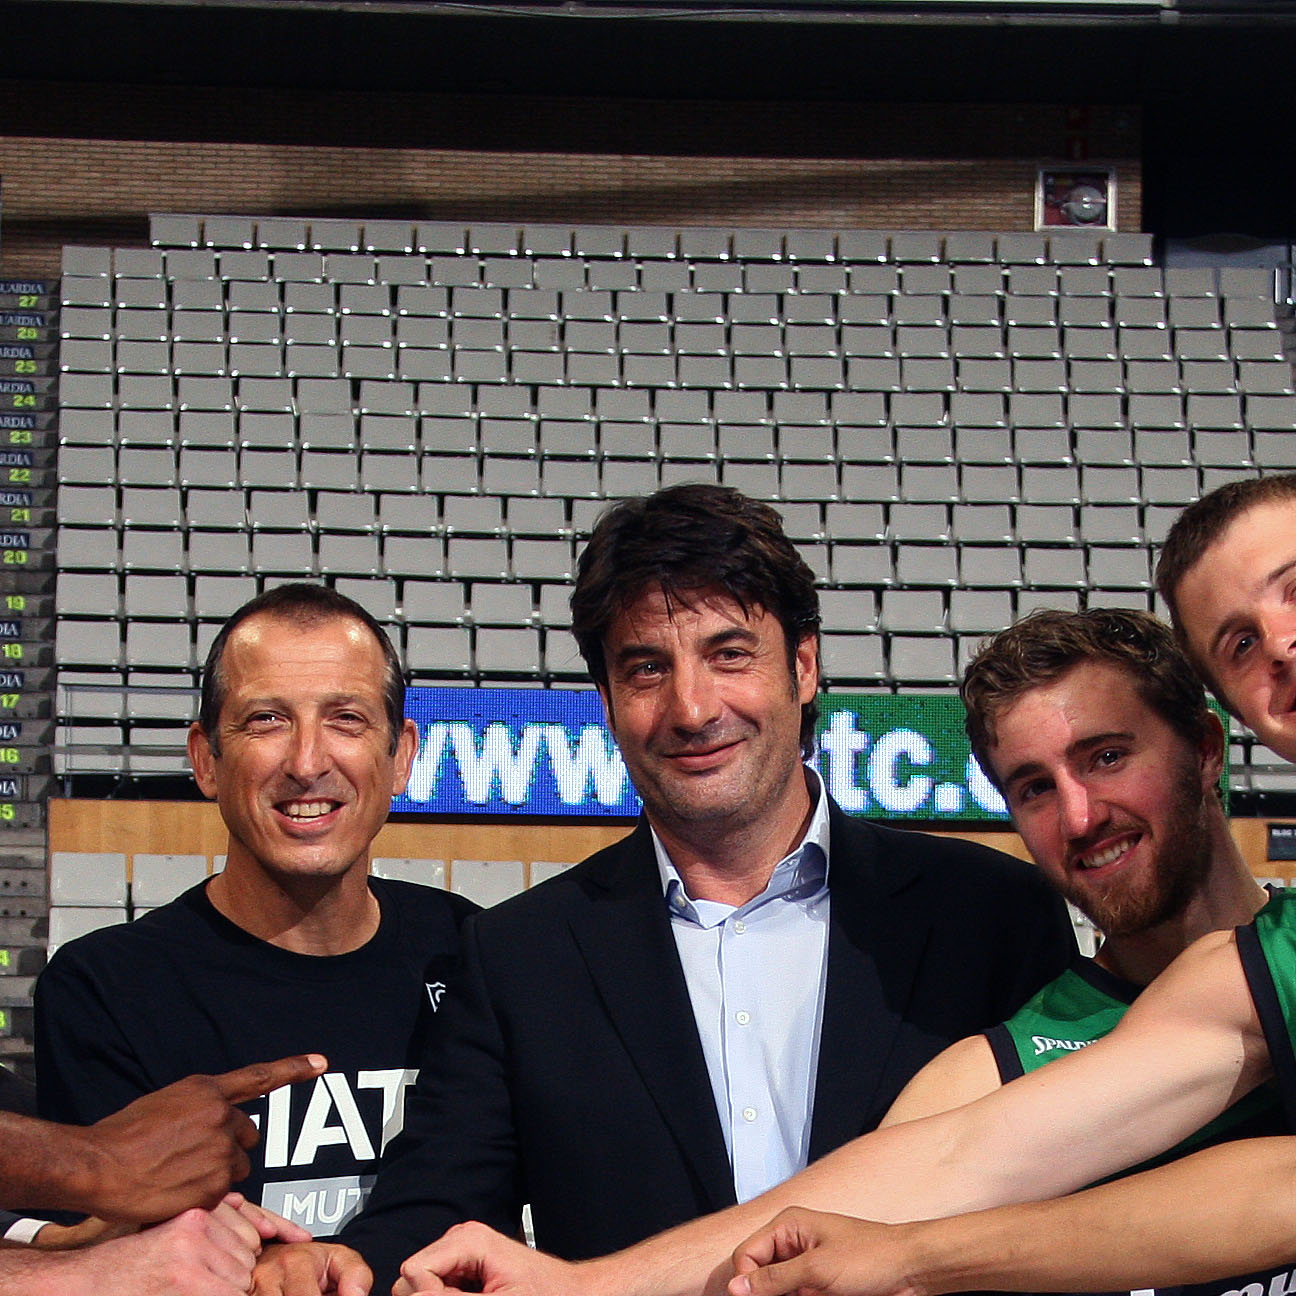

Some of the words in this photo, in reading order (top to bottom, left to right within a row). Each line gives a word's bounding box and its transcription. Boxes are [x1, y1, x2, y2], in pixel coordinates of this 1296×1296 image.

[18, 295, 39, 307] 27
[14, 360, 37, 373] 25
[13, 395, 37, 407] 24
[9, 430, 33, 444] 23
[8, 468, 32, 482] 22
[10, 508, 31, 522] 21
[3, 550, 28, 564] 20
[5, 595, 26, 611] 19
[2, 643, 24, 659] 18
[0, 693, 21, 709] 17
